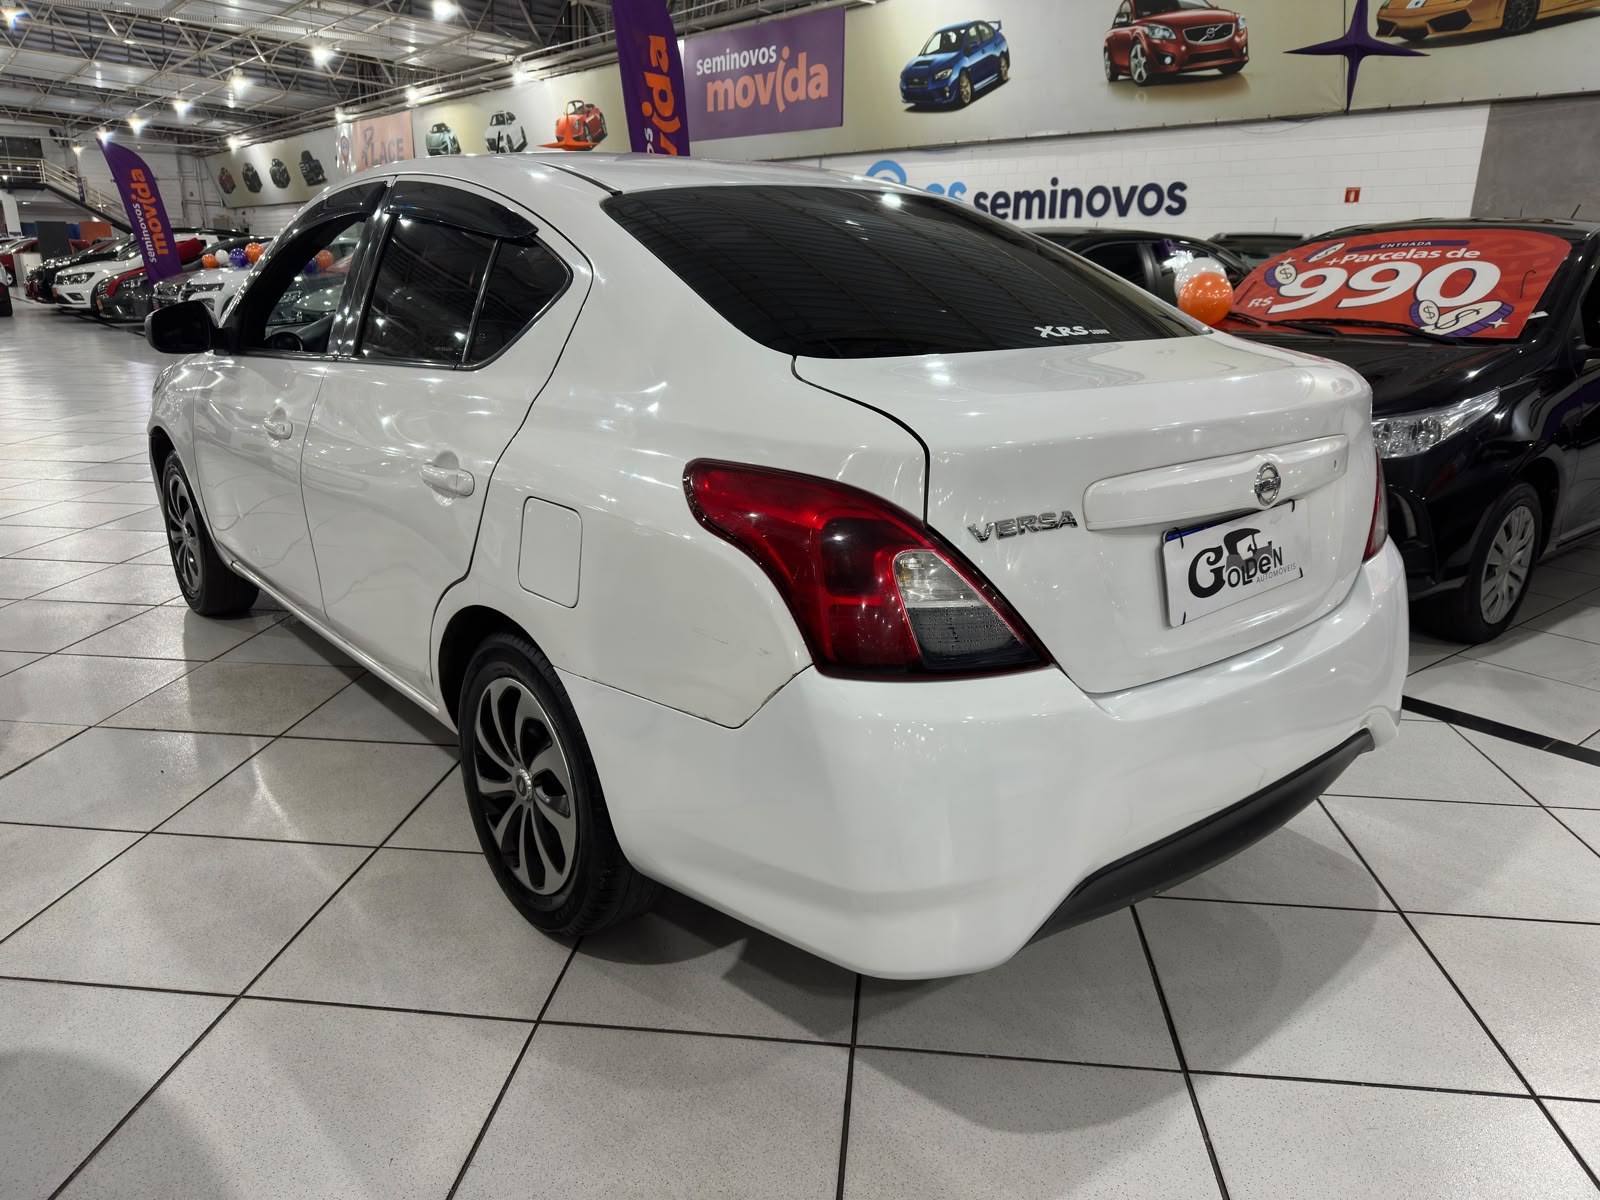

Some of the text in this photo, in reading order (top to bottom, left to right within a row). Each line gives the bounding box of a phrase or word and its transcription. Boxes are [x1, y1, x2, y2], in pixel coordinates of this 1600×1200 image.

[696, 44, 777, 76] seminovos
[706, 46, 829, 113] movida
[130, 168, 169, 255] movida
[973, 177, 1187, 220] seminovos
[132, 202, 157, 263] seminovos
[1380, 241, 1432, 249] ENTRADA
[1446, 248, 1481, 259] de
[1033, 325, 1089, 338] XRS
[967, 510, 1078, 543] VERSA
